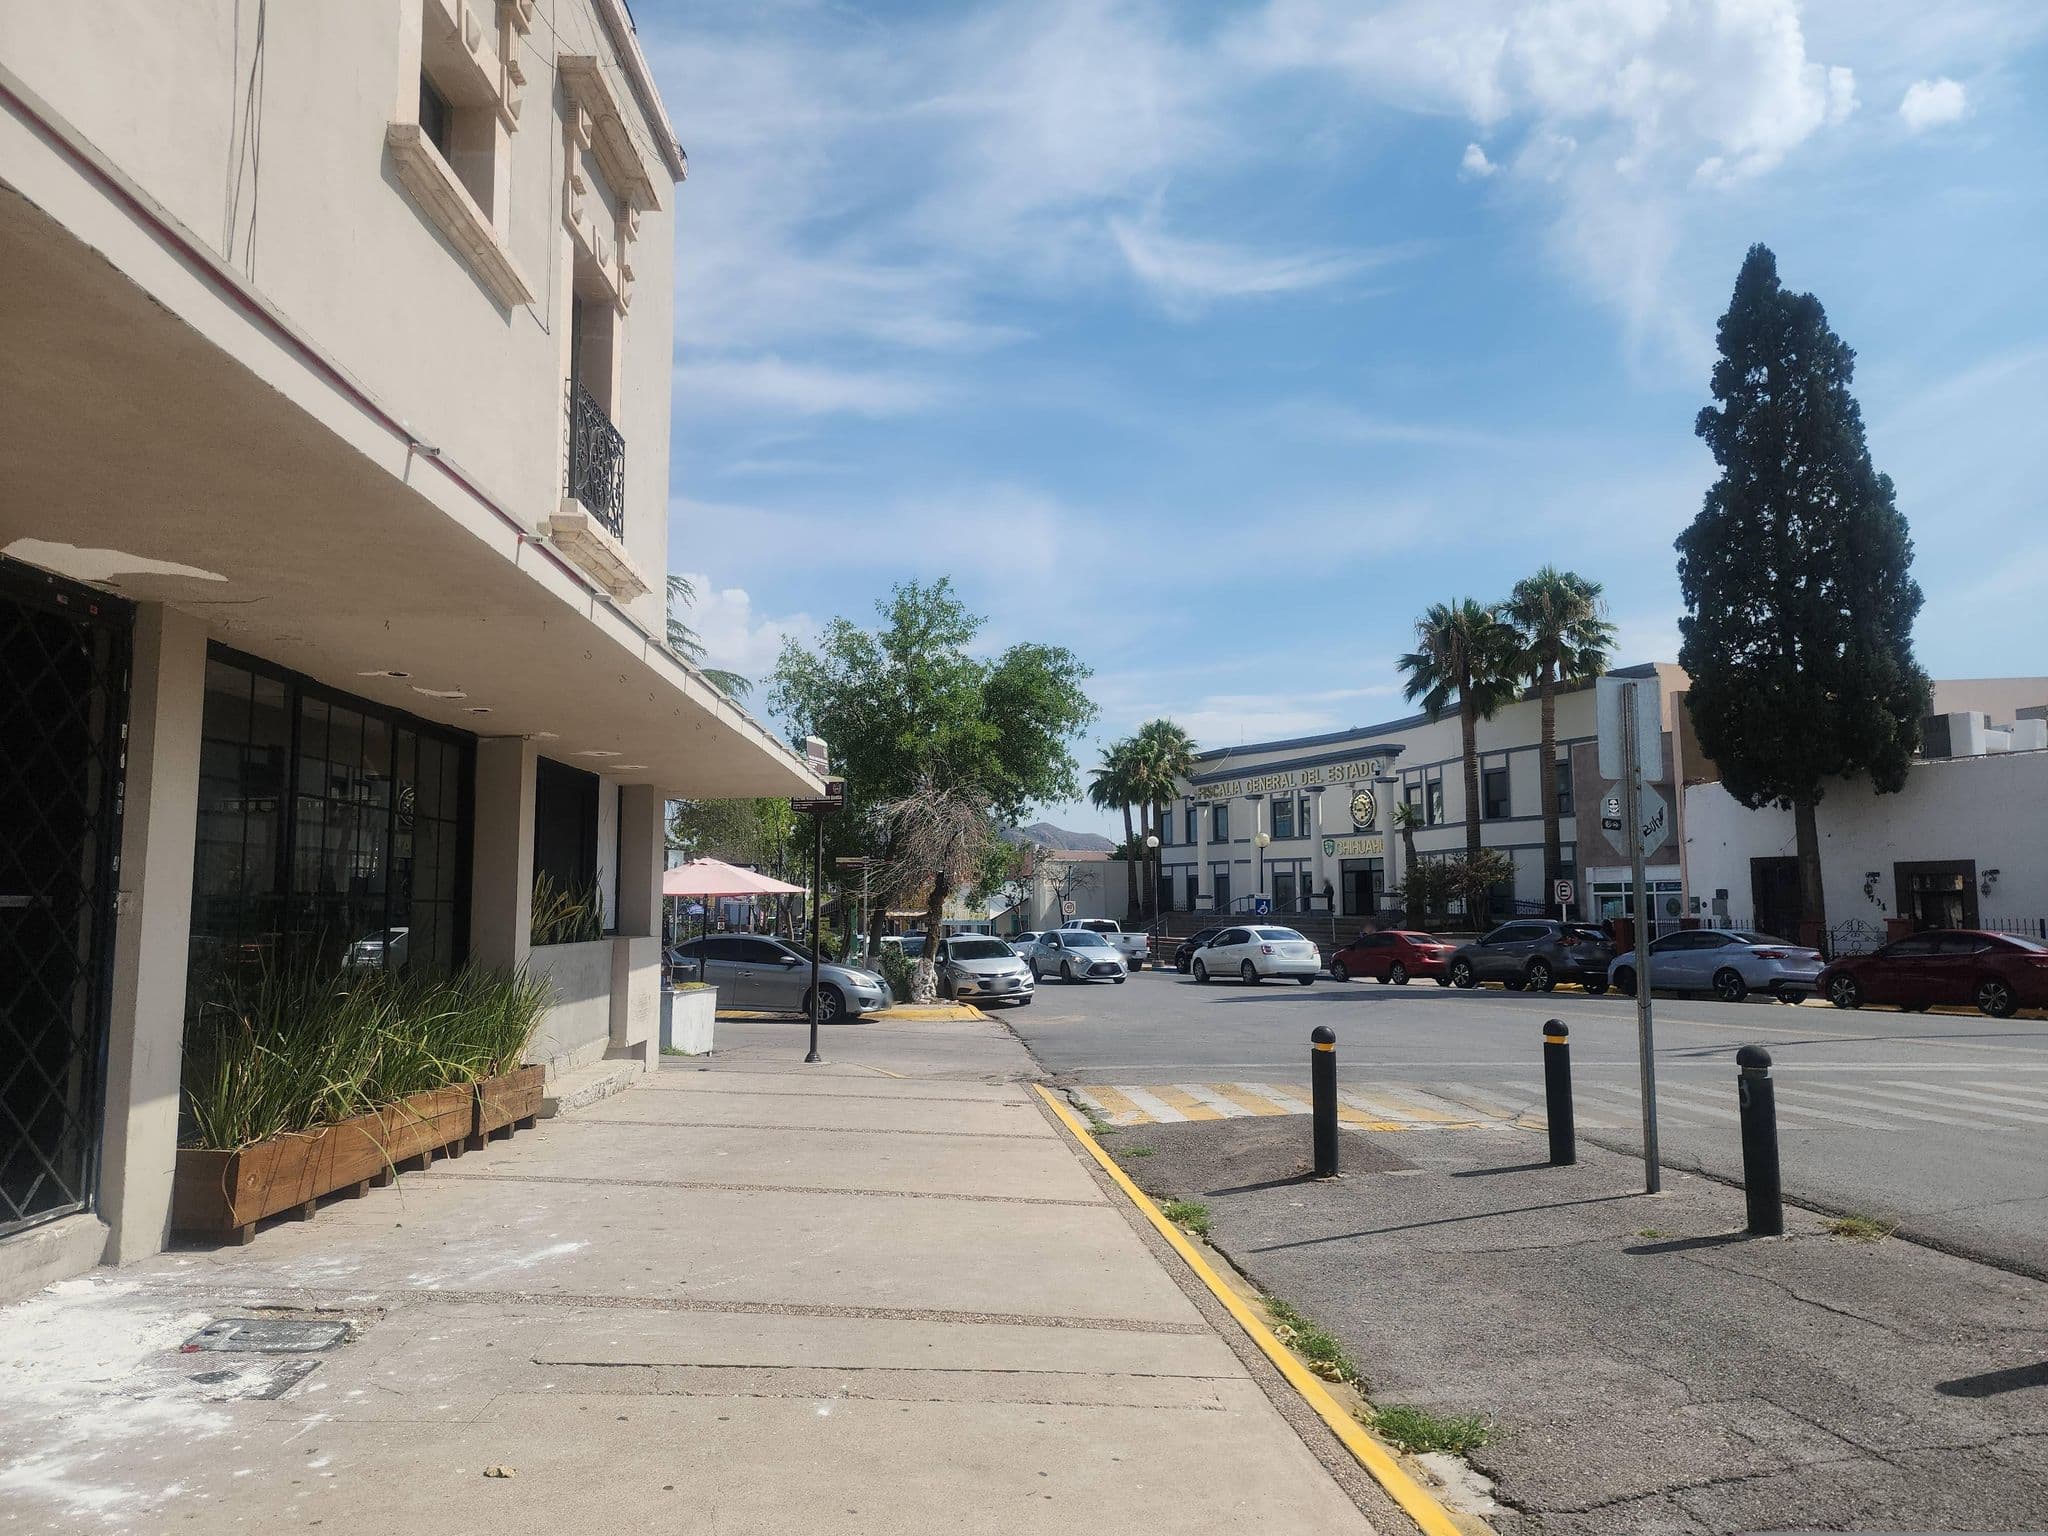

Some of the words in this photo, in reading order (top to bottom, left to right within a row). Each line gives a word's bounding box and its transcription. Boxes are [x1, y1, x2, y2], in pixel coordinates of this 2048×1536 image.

[1246, 772, 1297, 793] GENERAL
[1301, 768, 1324, 786] DEL
[1328, 759, 1380, 782] ESTADO
[1560, 884, 1569, 897] E
